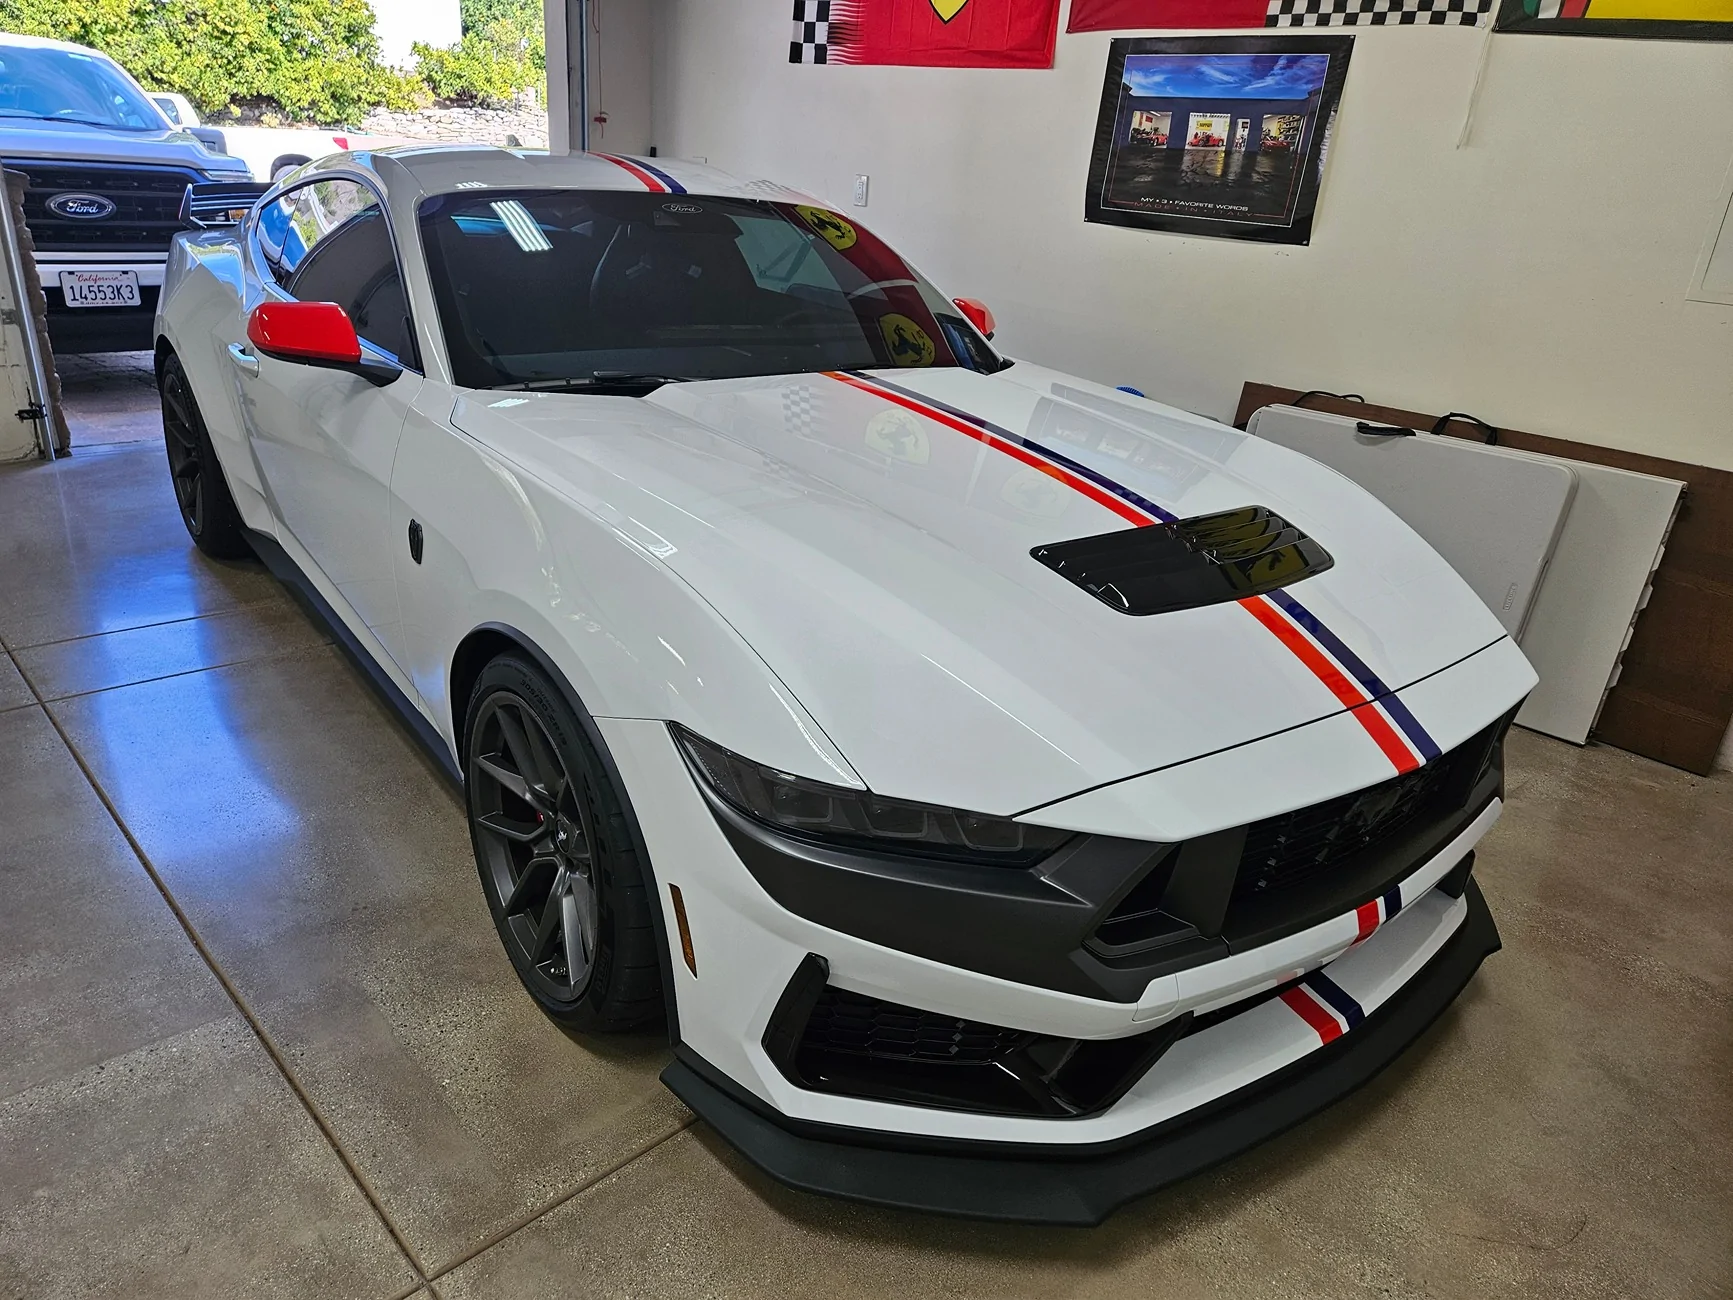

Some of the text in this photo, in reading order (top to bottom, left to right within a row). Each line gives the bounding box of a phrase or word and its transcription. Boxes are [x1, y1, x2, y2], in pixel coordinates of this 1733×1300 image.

[66, 199, 99, 213] Ford
[670, 204, 695, 212] Ford
[1134, 201, 1171, 210] MADE
[1213, 209, 1253, 217] ITALY
[1174, 200, 1214, 209] FAVORITE
[1215, 203, 1249, 212] WORDS
[77, 273, 120, 285] California
[69, 284, 135, 302] 14553K3
